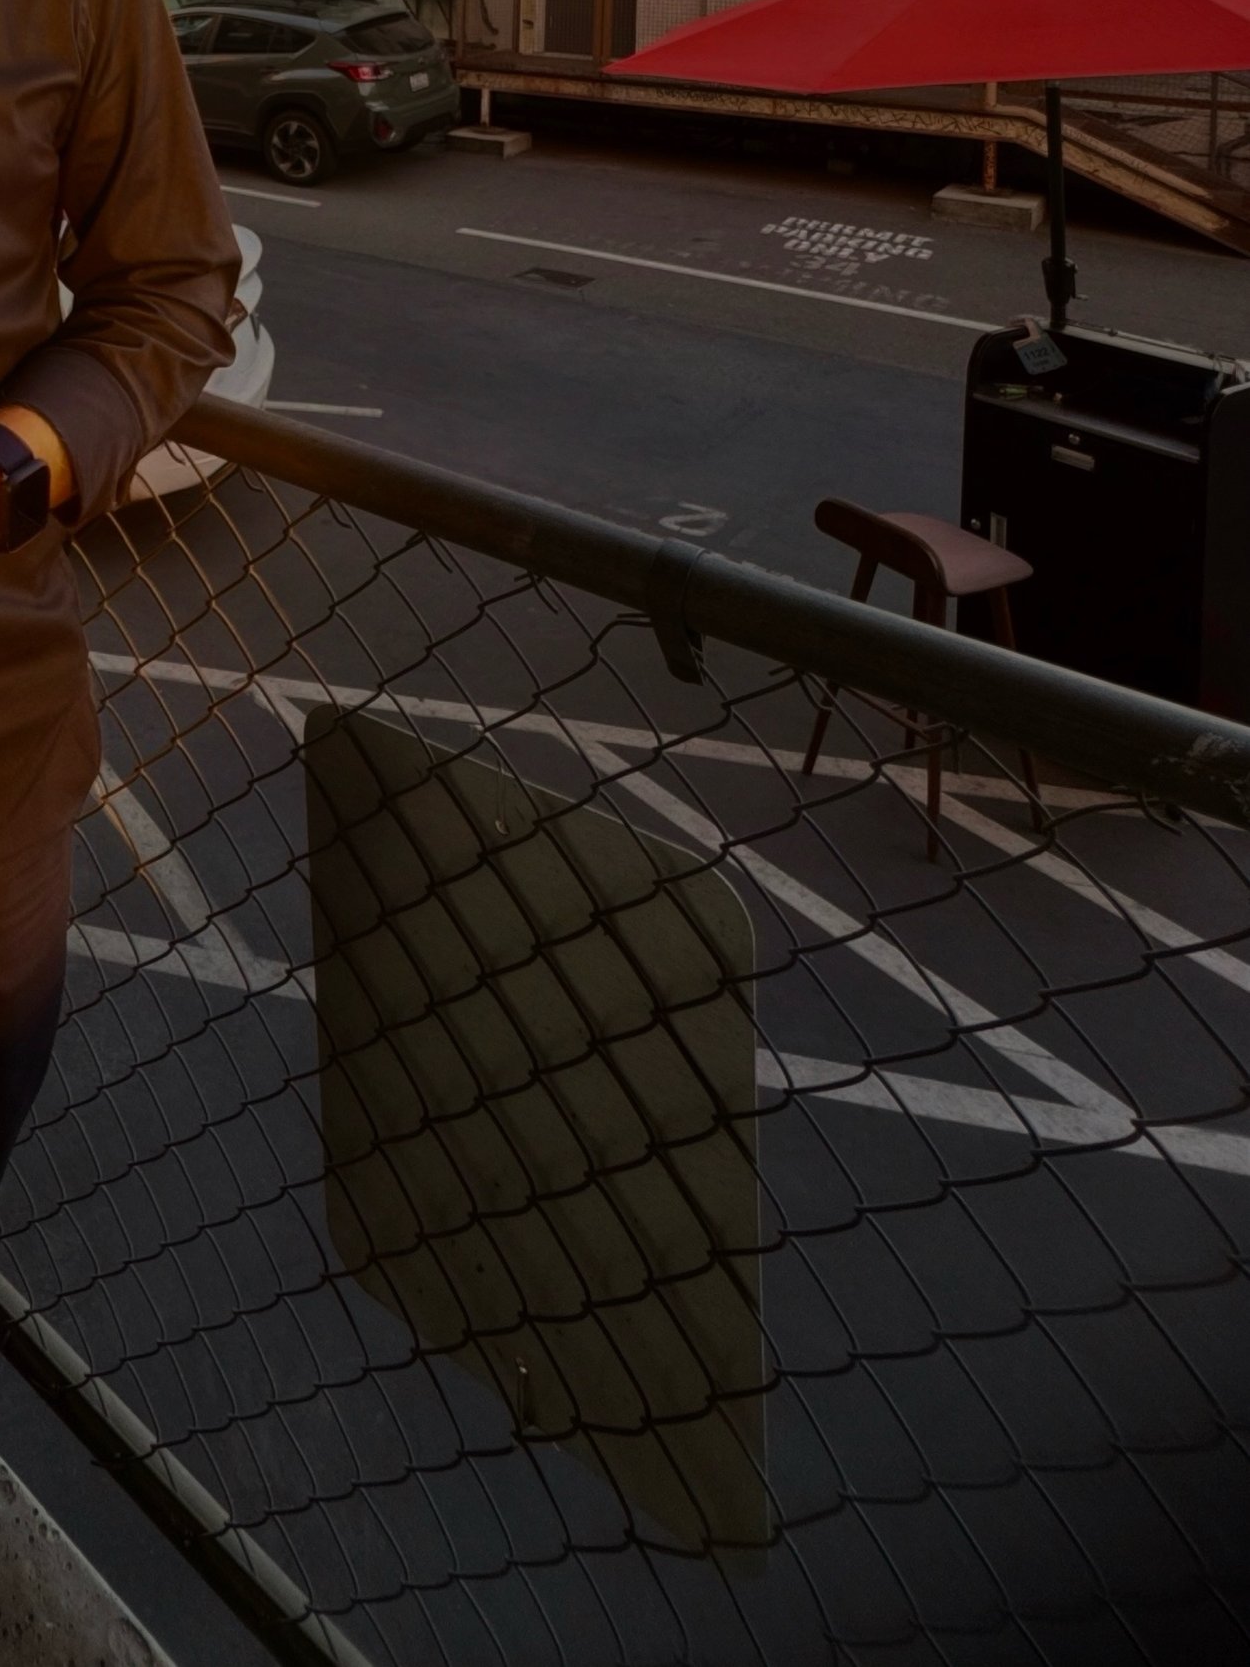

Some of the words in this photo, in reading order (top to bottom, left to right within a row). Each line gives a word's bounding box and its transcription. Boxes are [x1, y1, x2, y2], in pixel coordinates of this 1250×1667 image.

[760, 223, 934, 260] PARKING
[782, 217, 934, 247] PERMIT
[783, 239, 890, 264] ONLY
[790, 255, 861, 276] 34
